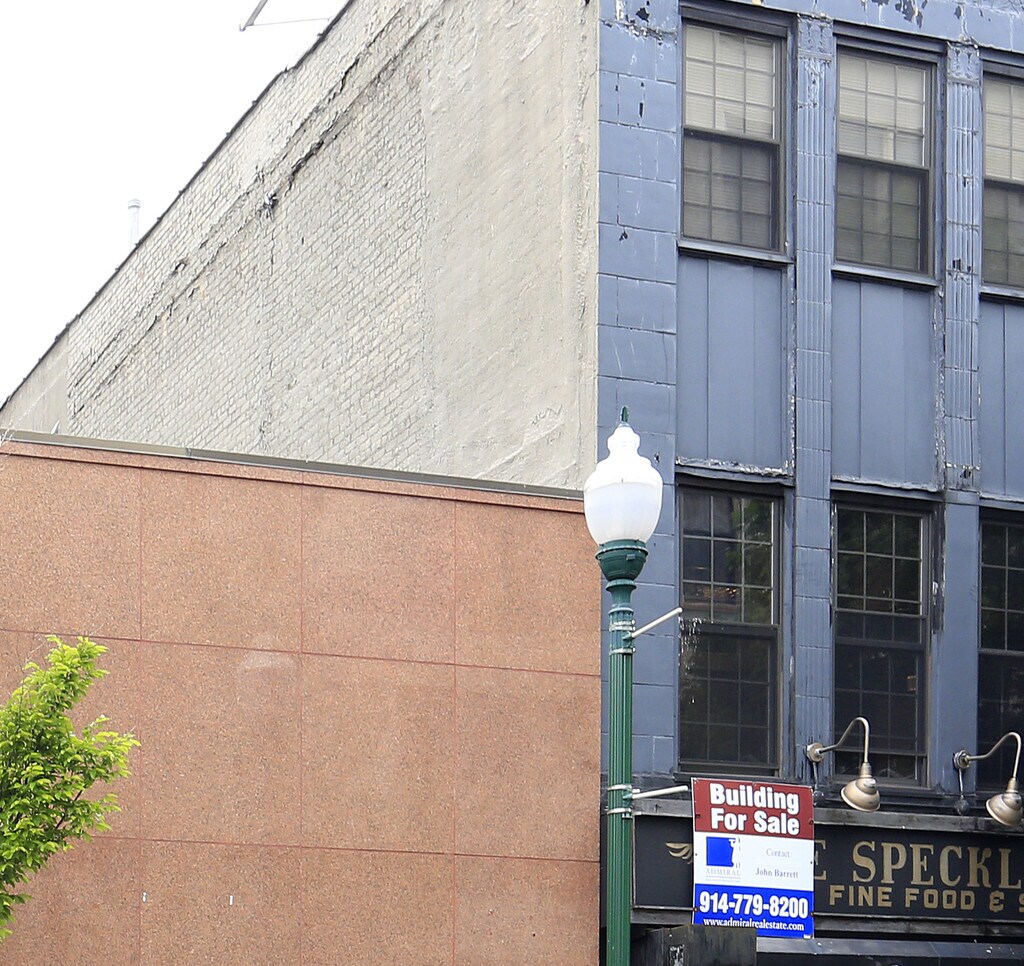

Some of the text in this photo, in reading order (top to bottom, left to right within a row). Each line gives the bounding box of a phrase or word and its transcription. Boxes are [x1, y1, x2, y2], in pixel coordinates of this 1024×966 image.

[709, 783, 799, 815] Building
[711, 807, 800, 835] For Sale
[766, 848, 790, 858] Contact
[852, 841, 1021, 889] SPECKL
[755, 867, 799, 879] John Barrett
[699, 891, 809, 919] 914-779-8200
[829, 884, 892, 908] FINE
[905, 887, 975, 910] FOOD
[989, 890, 1005, 912] &
[703, 917, 805, 931] www.admiralrealestate.com
